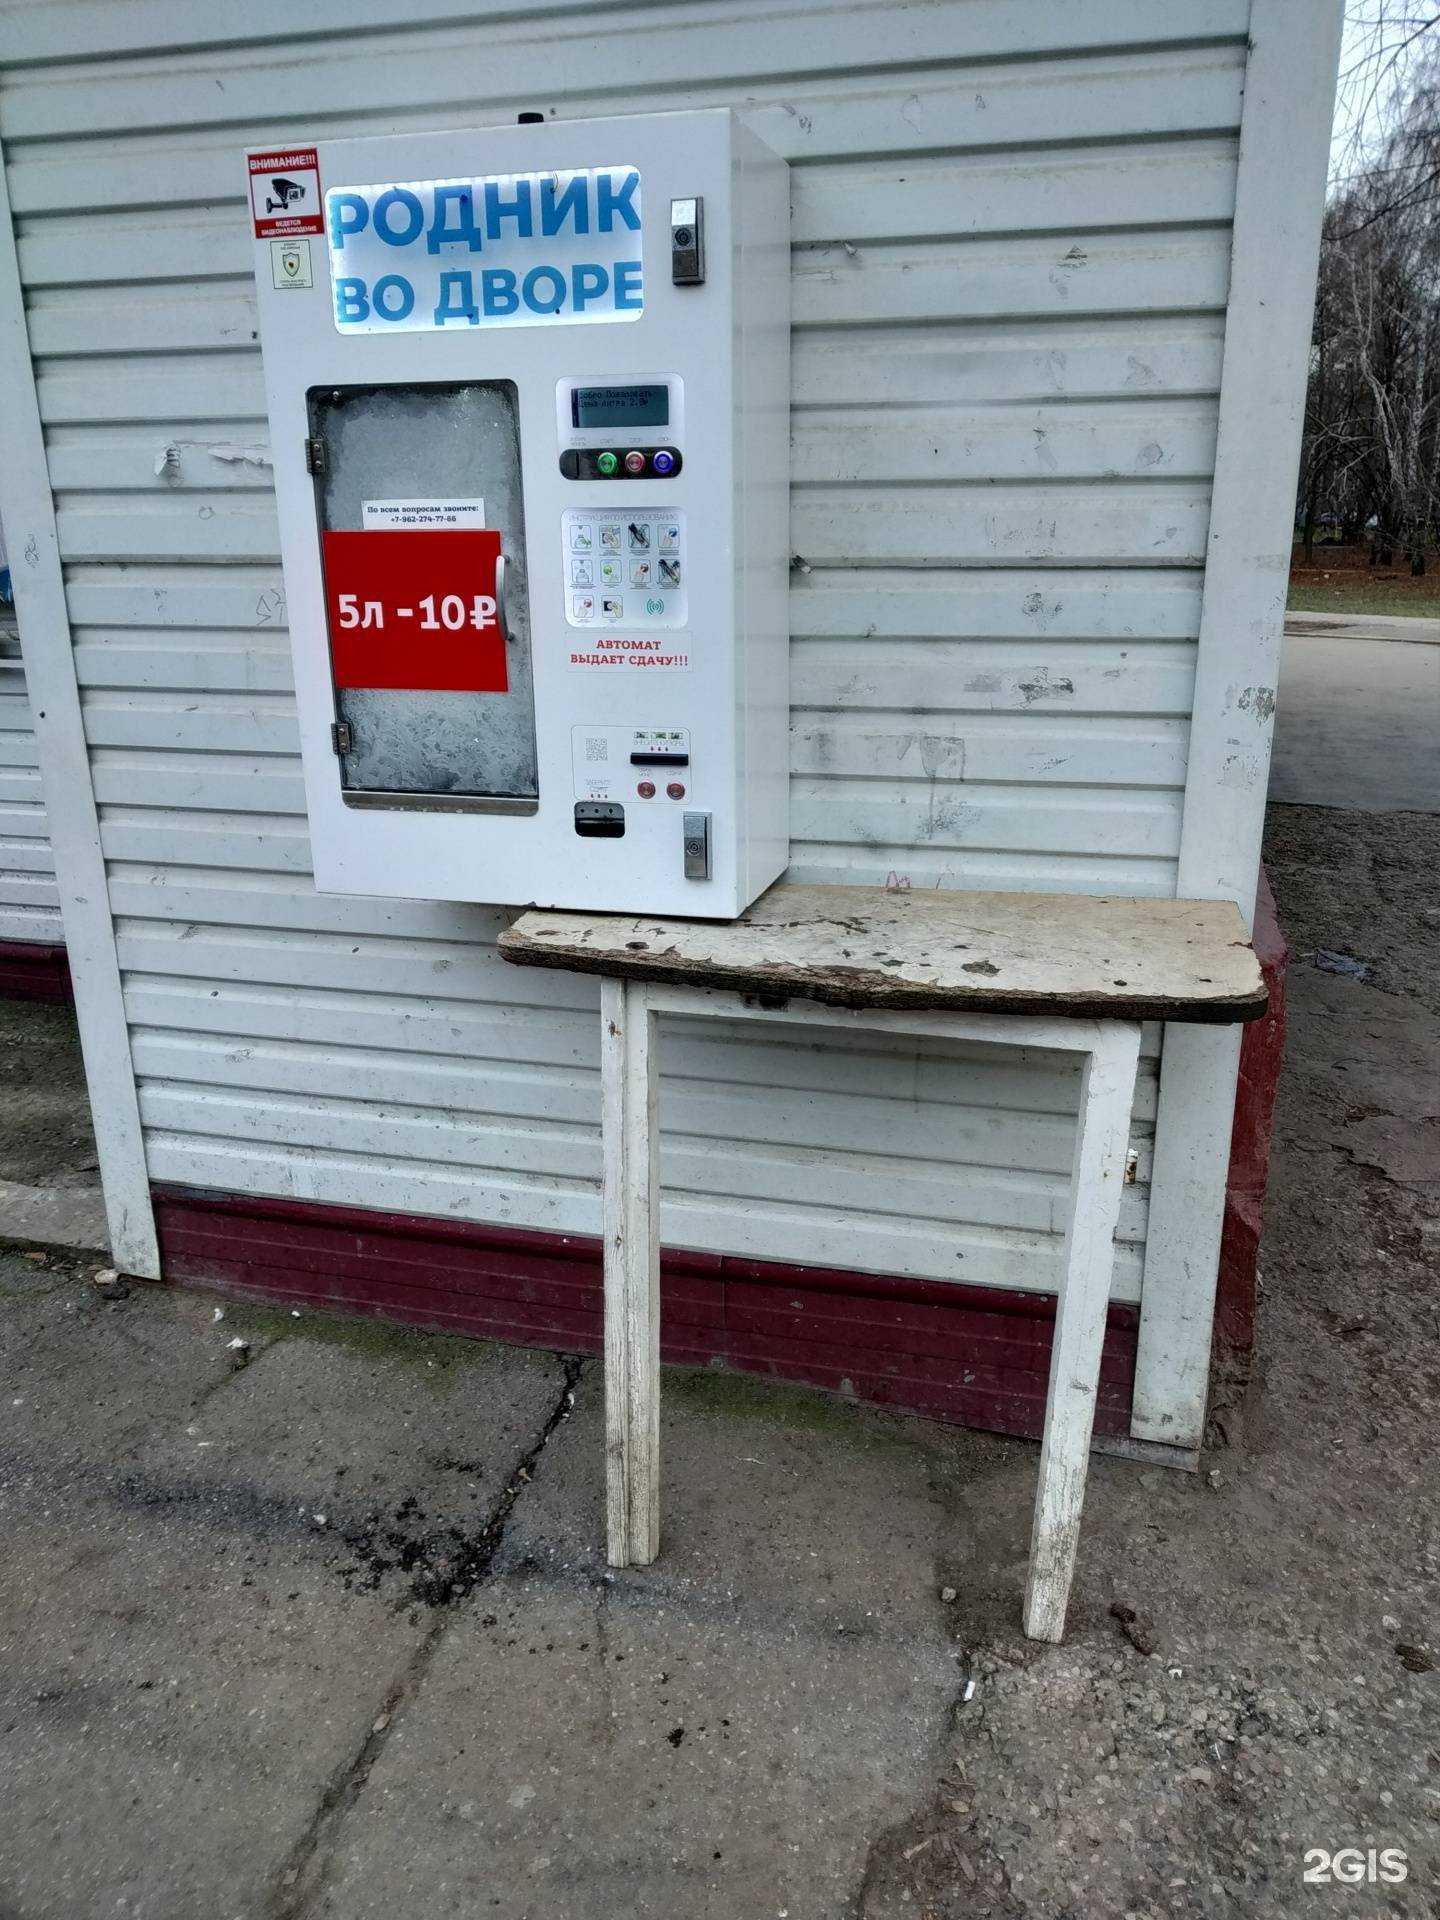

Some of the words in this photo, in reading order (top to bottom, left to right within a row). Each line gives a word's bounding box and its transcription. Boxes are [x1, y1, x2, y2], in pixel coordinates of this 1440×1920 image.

[249, 153, 316, 171] ВНИМАНИЕ!!!
[330, 172, 641, 255] РОДНИК
[335, 273, 415, 323] ВО
[433, 260, 643, 326] ДВОРЕ
[367, 506, 379, 514] По
[402, 506, 441, 515] вопросам
[443, 505, 479, 513] звоните:
[338, 594, 384, 629] 5л
[596, 639, 662, 651] АВТОМАТ
[570, 654, 625, 666] ВЫДАЕТ
[628, 654, 688, 667] СДАЧУ!!!
